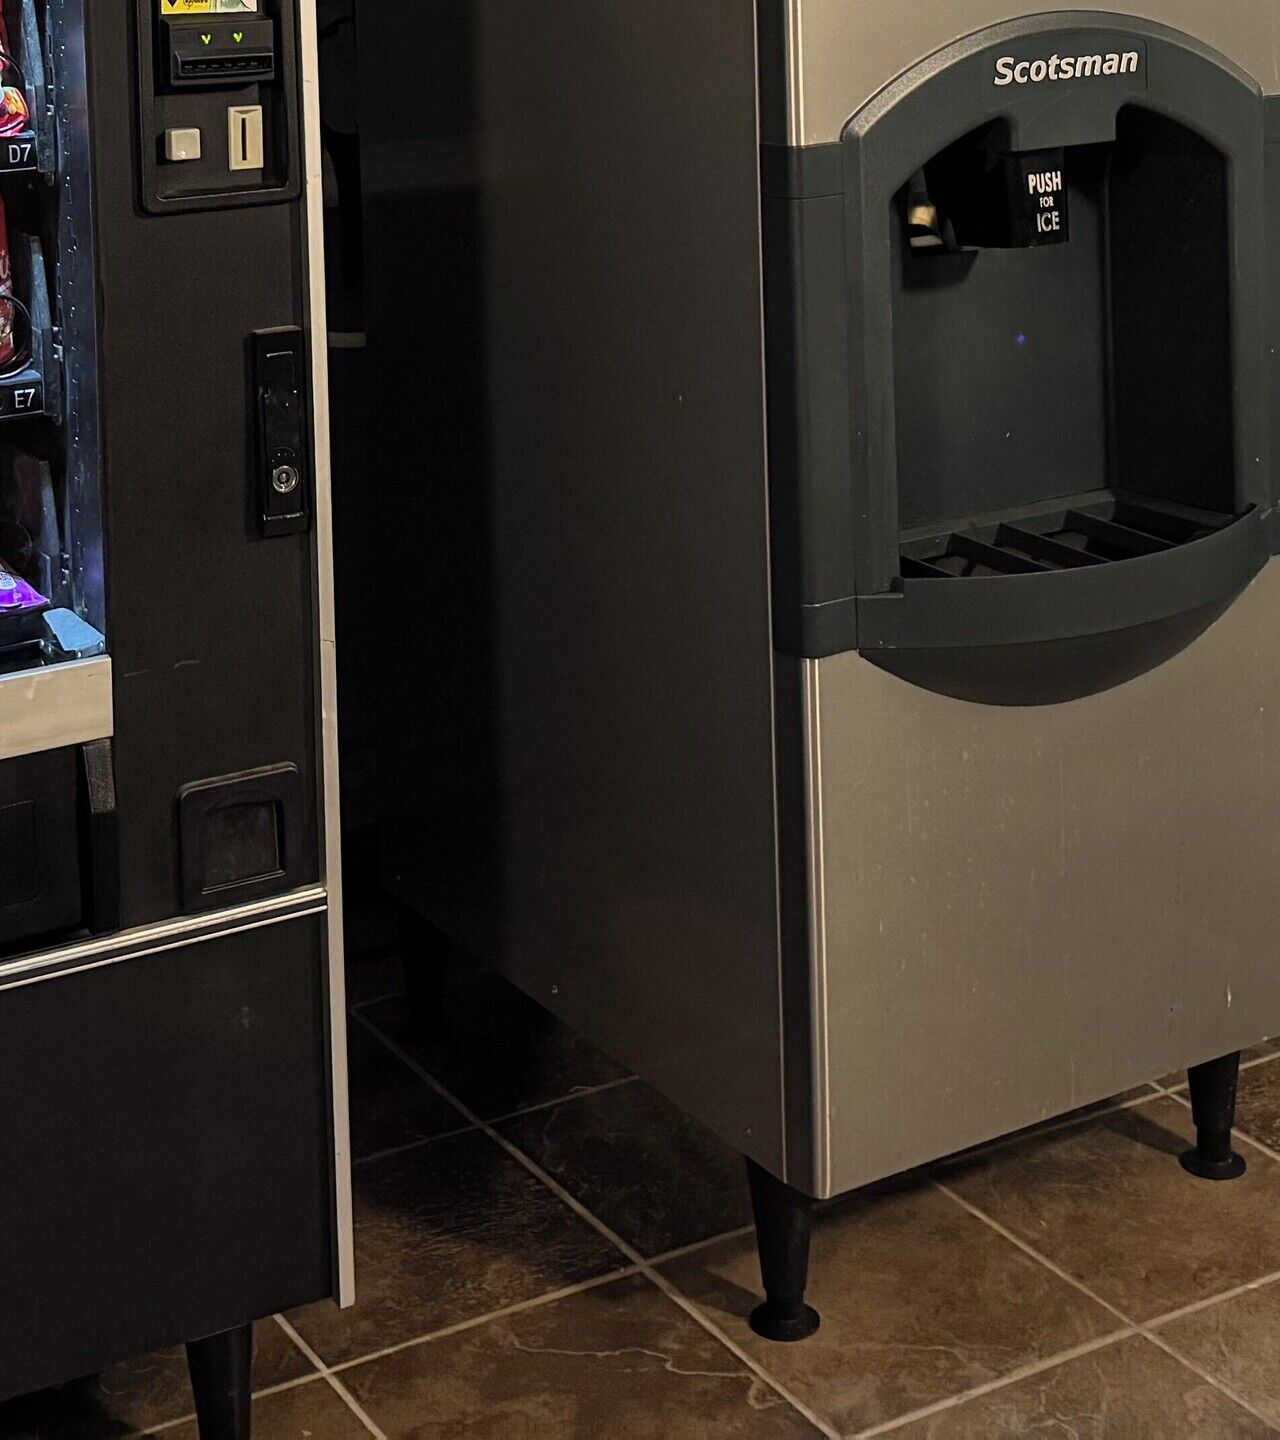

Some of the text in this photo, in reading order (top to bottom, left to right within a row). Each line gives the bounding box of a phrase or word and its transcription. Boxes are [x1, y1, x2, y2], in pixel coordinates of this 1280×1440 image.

[994, 50, 1139, 86] Scotsman
[9, 145, 31, 164] D7
[1028, 171, 1062, 194] PUSH
[1039, 196, 1054, 208] FOR
[1036, 211, 1060, 233] ICE
[15, 389, 36, 409] E7
